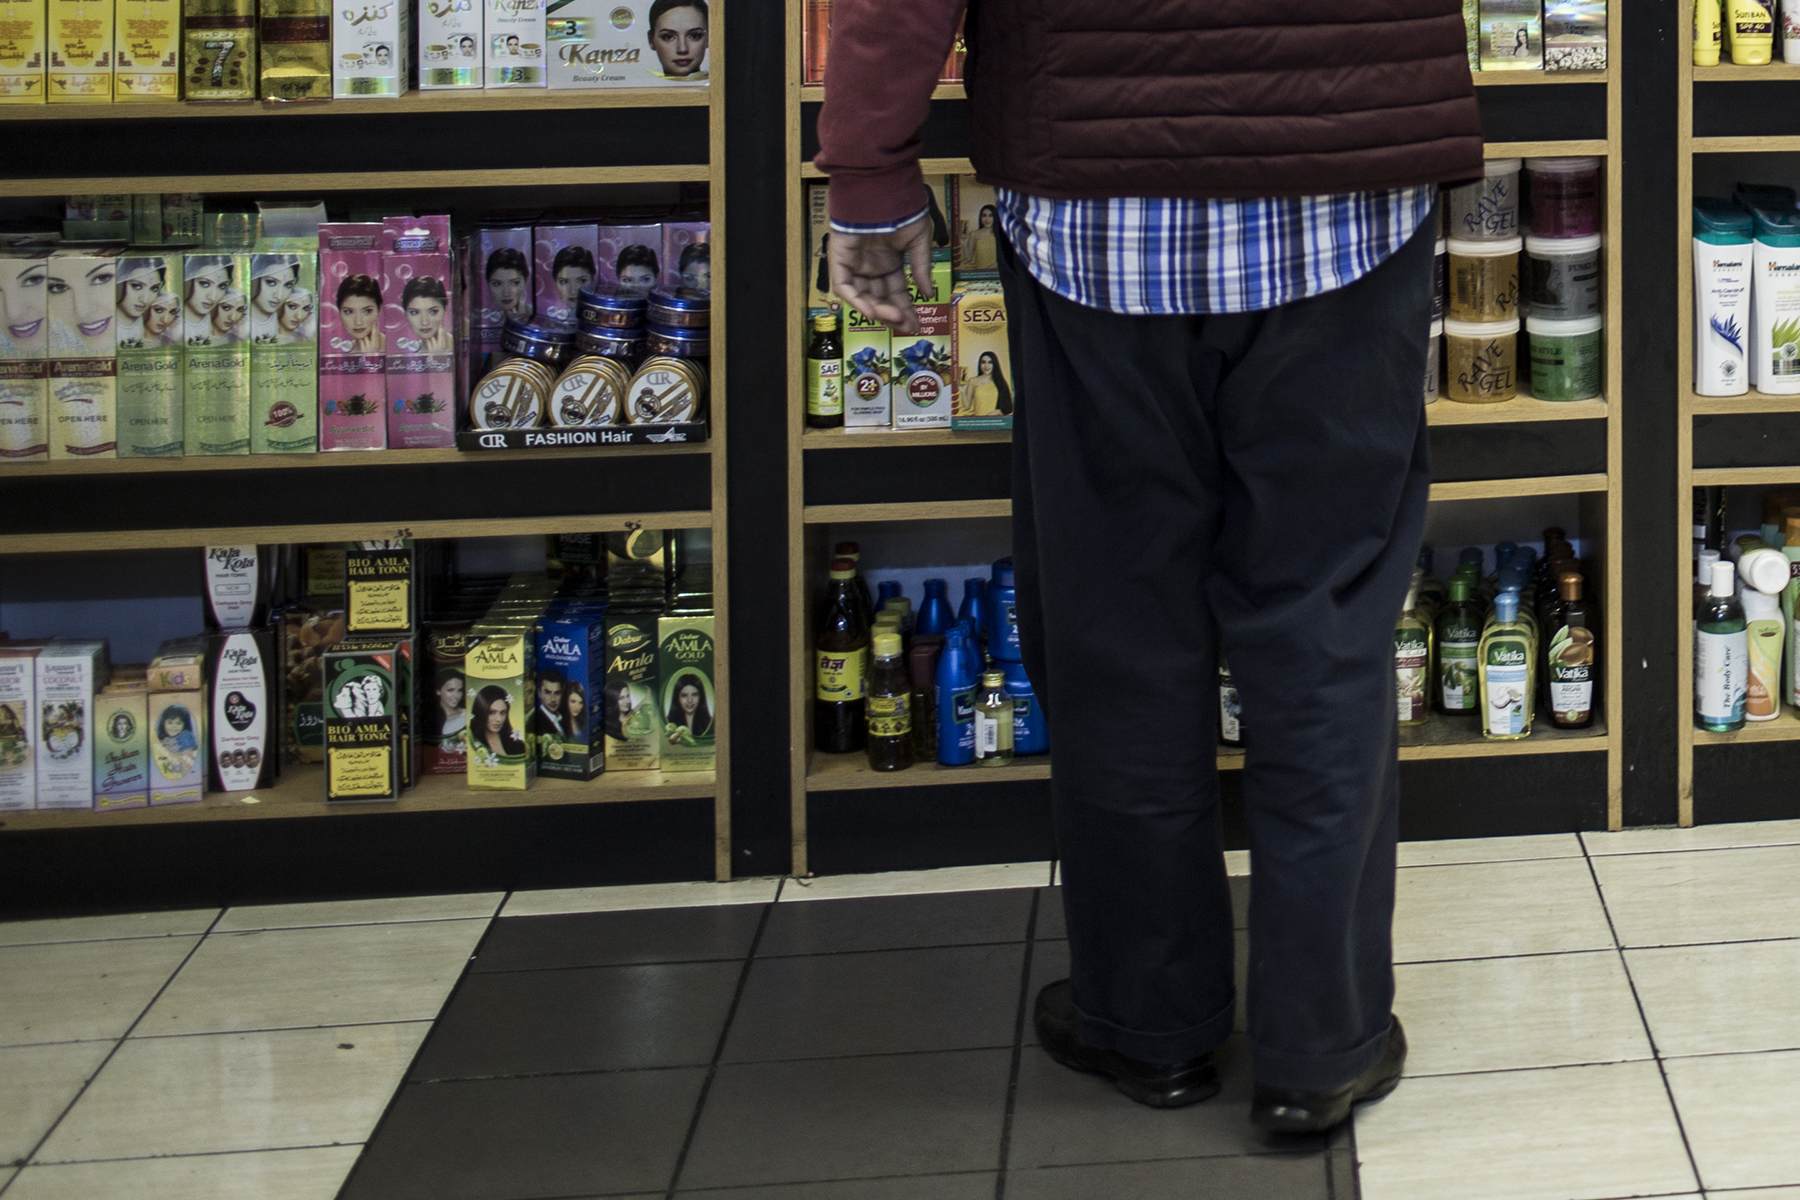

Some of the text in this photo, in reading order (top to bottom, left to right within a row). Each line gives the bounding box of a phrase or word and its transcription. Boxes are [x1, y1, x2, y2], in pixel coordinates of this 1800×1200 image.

[565, 21, 578, 36] 3
[1738, 24, 1752, 32] SPF
[205, 41, 235, 87] 7
[558, 43, 641, 74] Kanza
[515, 69, 524, 81] 3
[573, 74, 599, 83] Beauty
[1463, 179, 1509, 233] RAVE
[1485, 211, 1516, 233] GEL
[963, 310, 1006, 323] SESA
[820, 364, 839, 375] SAFI
[1457, 340, 1504, 392] RAVE
[1479, 370, 1513, 393] GEL
[14, 416, 39, 425] HERE
[59, 414, 108, 424] OPEN HERE
[526, 431, 633, 446] FASHION Hair
[208, 548, 240, 559] Kala
[223, 557, 256, 571] Kola
[348, 557, 410, 567] BIO AMLA
[349, 566, 410, 575] HAIR TONIC
[1448, 628, 1476, 639] Vatika
[613, 634, 642, 647] Dabur
[665, 639, 712, 653] AMLA
[223, 648, 247, 660] Kala
[541, 641, 581, 656] AMLA
[675, 651, 705, 659] GOLD
[234, 655, 258, 667] Kola
[473, 650, 518, 664] AMLA
[1495, 650, 1525, 662] Vatika
[607, 653, 654, 674] Amla
[1556, 666, 1589, 679] Vatika
[160, 672, 190, 687] Kids
[328, 724, 390, 735] BIO AMLA
[329, 732, 391, 742] HAIR TONIC
